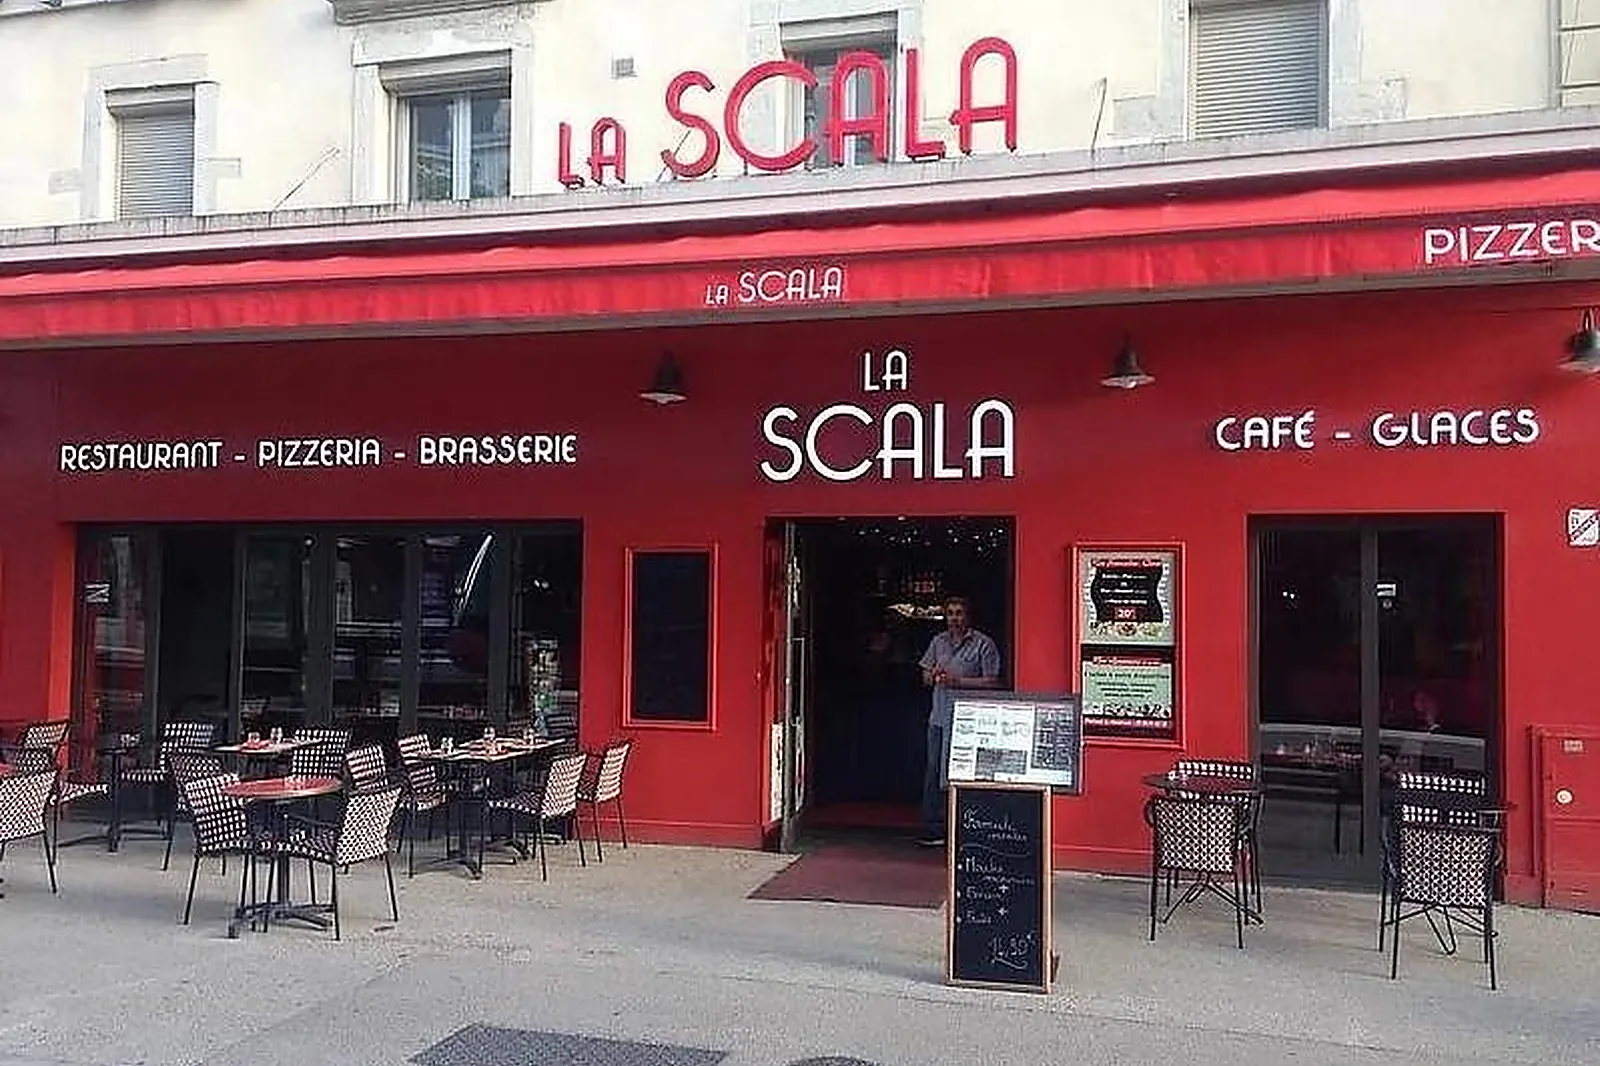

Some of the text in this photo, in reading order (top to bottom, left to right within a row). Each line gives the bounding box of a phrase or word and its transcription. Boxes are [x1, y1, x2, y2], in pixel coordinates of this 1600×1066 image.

[558, 36, 1018, 188] LA SCALA
[1424, 219, 1600, 265] PIZZER
[705, 267, 843, 305] LA SCALA
[864, 350, 908, 391] LA
[760, 400, 1015, 481] SCALA
[1216, 409, 1315, 450] CAFÉ
[1372, 409, 1540, 447] GLACES
[60, 441, 224, 471] RESTAURANT
[258, 438, 380, 468] PIZZERIA
[420, 434, 577, 465] BRASSERIE
